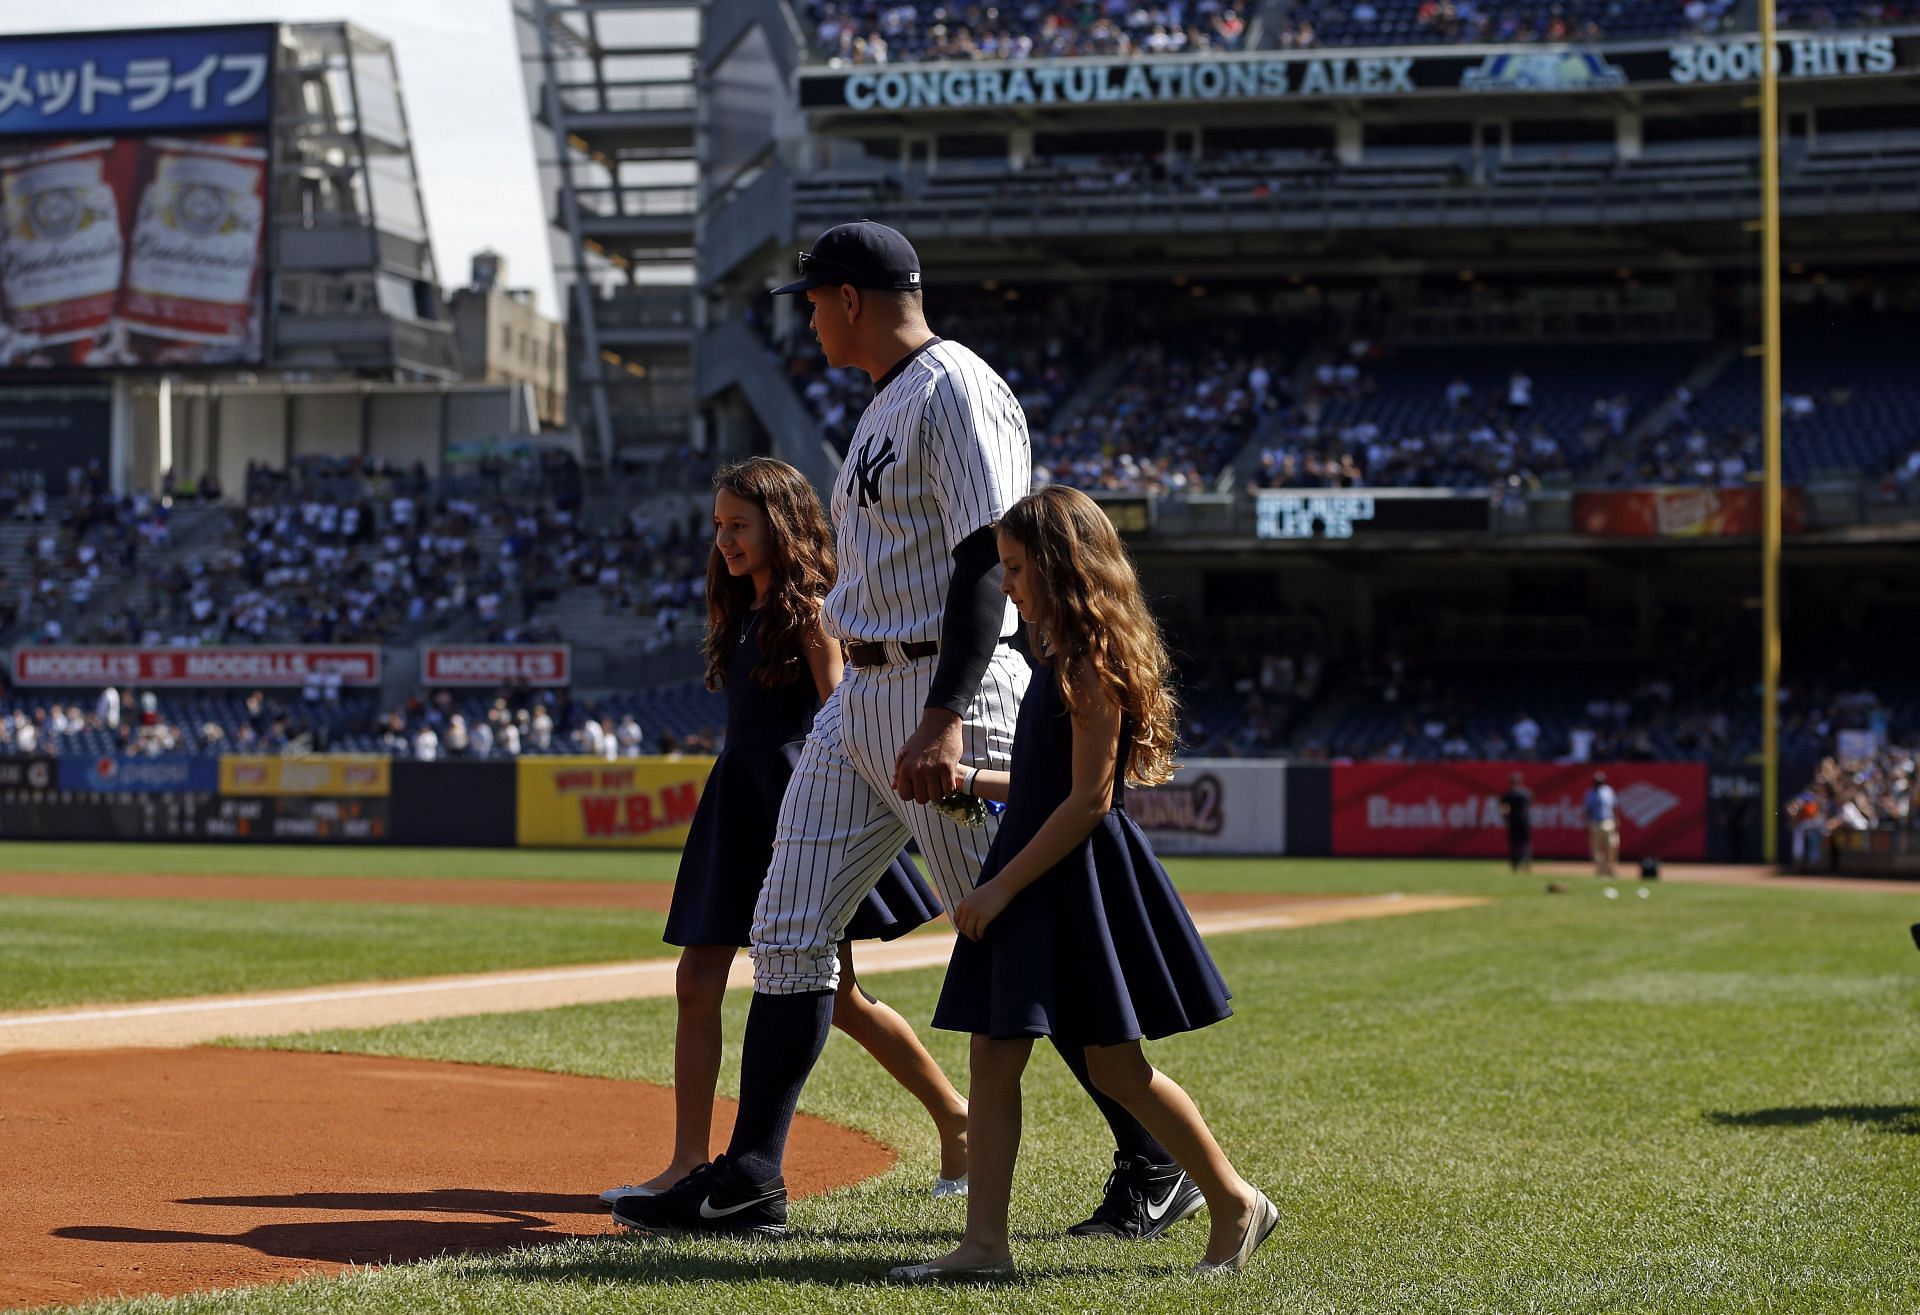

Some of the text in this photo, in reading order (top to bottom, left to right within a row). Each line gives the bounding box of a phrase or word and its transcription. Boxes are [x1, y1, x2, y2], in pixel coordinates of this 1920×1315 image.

[1792, 37, 1896, 74] HITS
[0, 54, 268, 116] メットライフ
[844, 59, 1415, 110] CONGRATULATIONS ALEX
[846, 433, 896, 509] NY
[581, 779, 703, 838] W.B.M
[1367, 796, 1585, 828] Bank of Aeric
